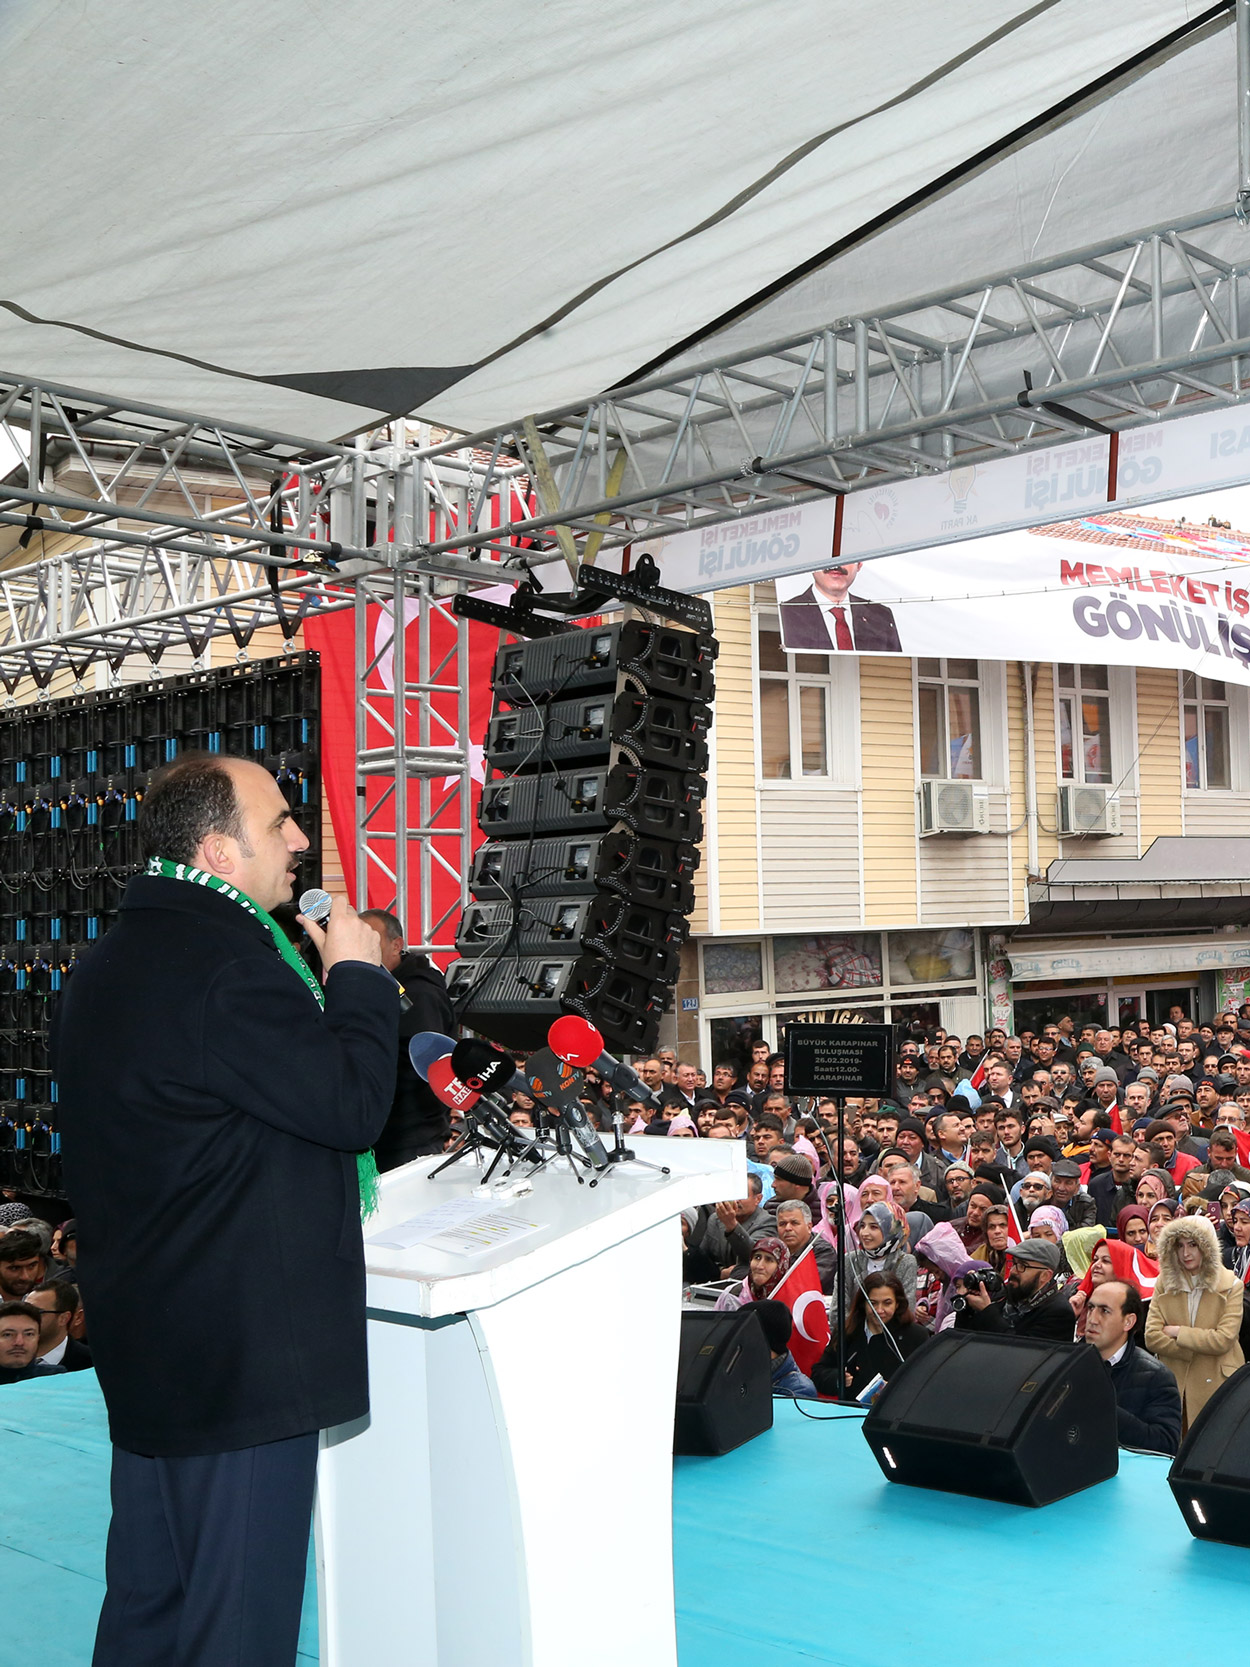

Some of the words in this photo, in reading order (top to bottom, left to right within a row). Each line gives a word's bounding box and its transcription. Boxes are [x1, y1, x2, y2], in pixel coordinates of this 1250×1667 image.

[1060, 559, 1220, 607] MEMLEKET
[1072, 591, 1221, 656] GÖNÜL
[797, 1038, 827, 1046] BÜYÜK
[814, 1048, 863, 1056] BULUŞMASI
[477, 1061, 501, 1082] İHA
[813, 1074, 863, 1082] KARAPINAR
